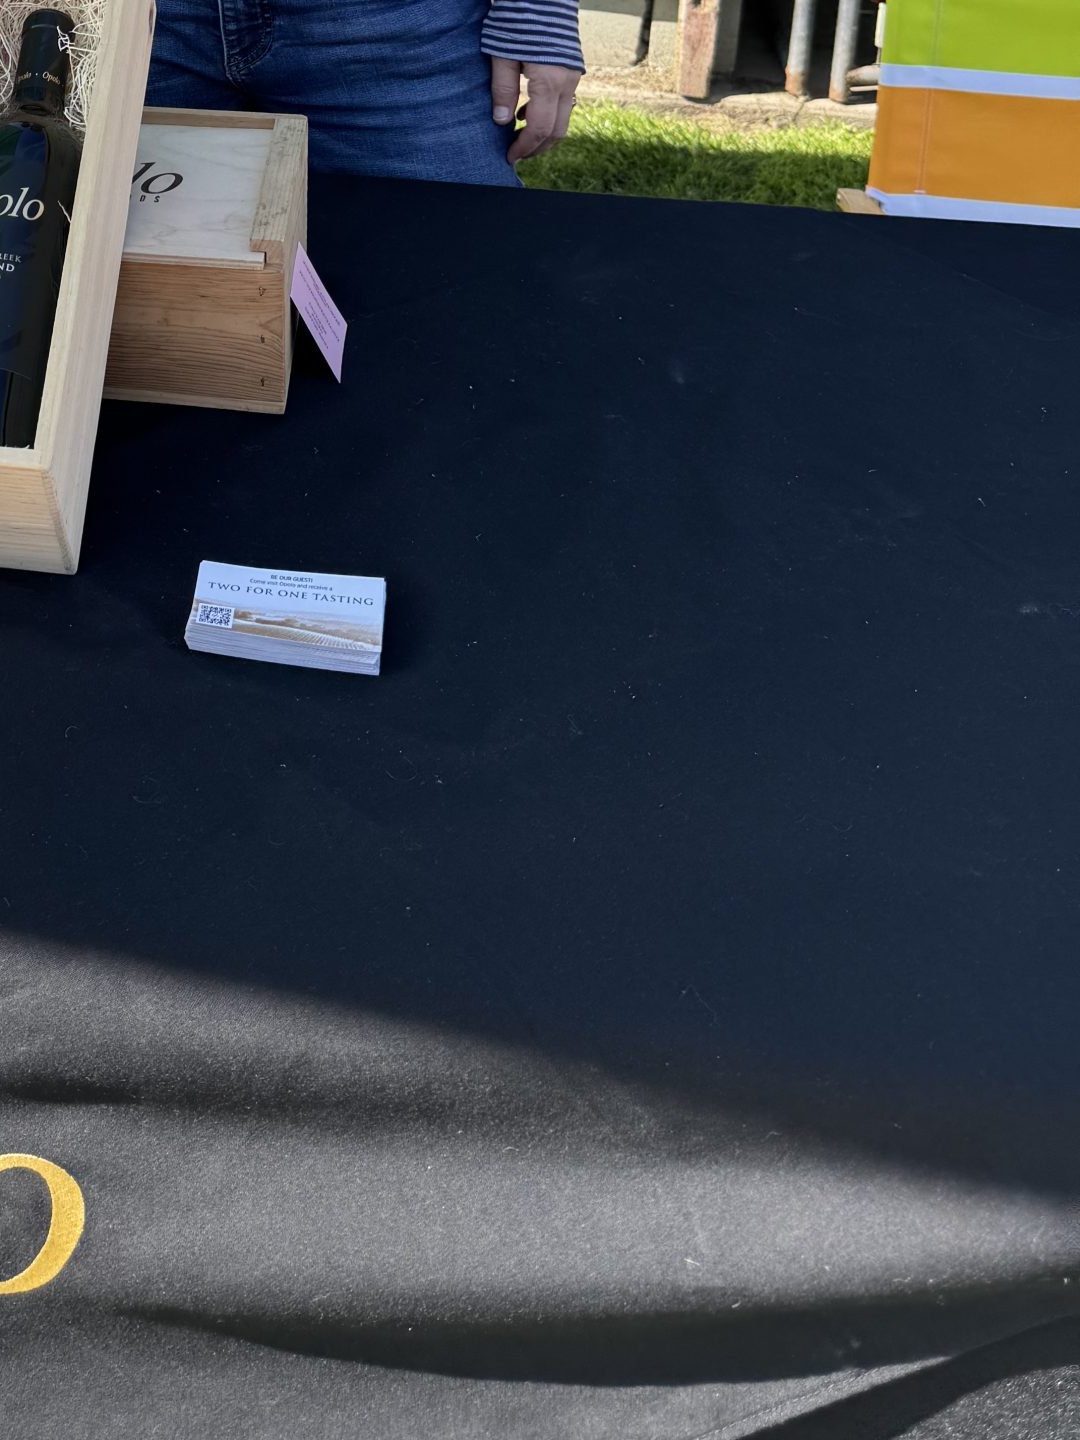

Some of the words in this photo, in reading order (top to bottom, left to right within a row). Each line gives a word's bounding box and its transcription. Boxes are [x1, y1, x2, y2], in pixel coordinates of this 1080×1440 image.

[42, 71, 61, 85] Opolo
[208, 581, 241, 592] TWO
[246, 586, 273, 596] FOR
[278, 589, 308, 599] ONE
[312, 592, 374, 606] TASTING
